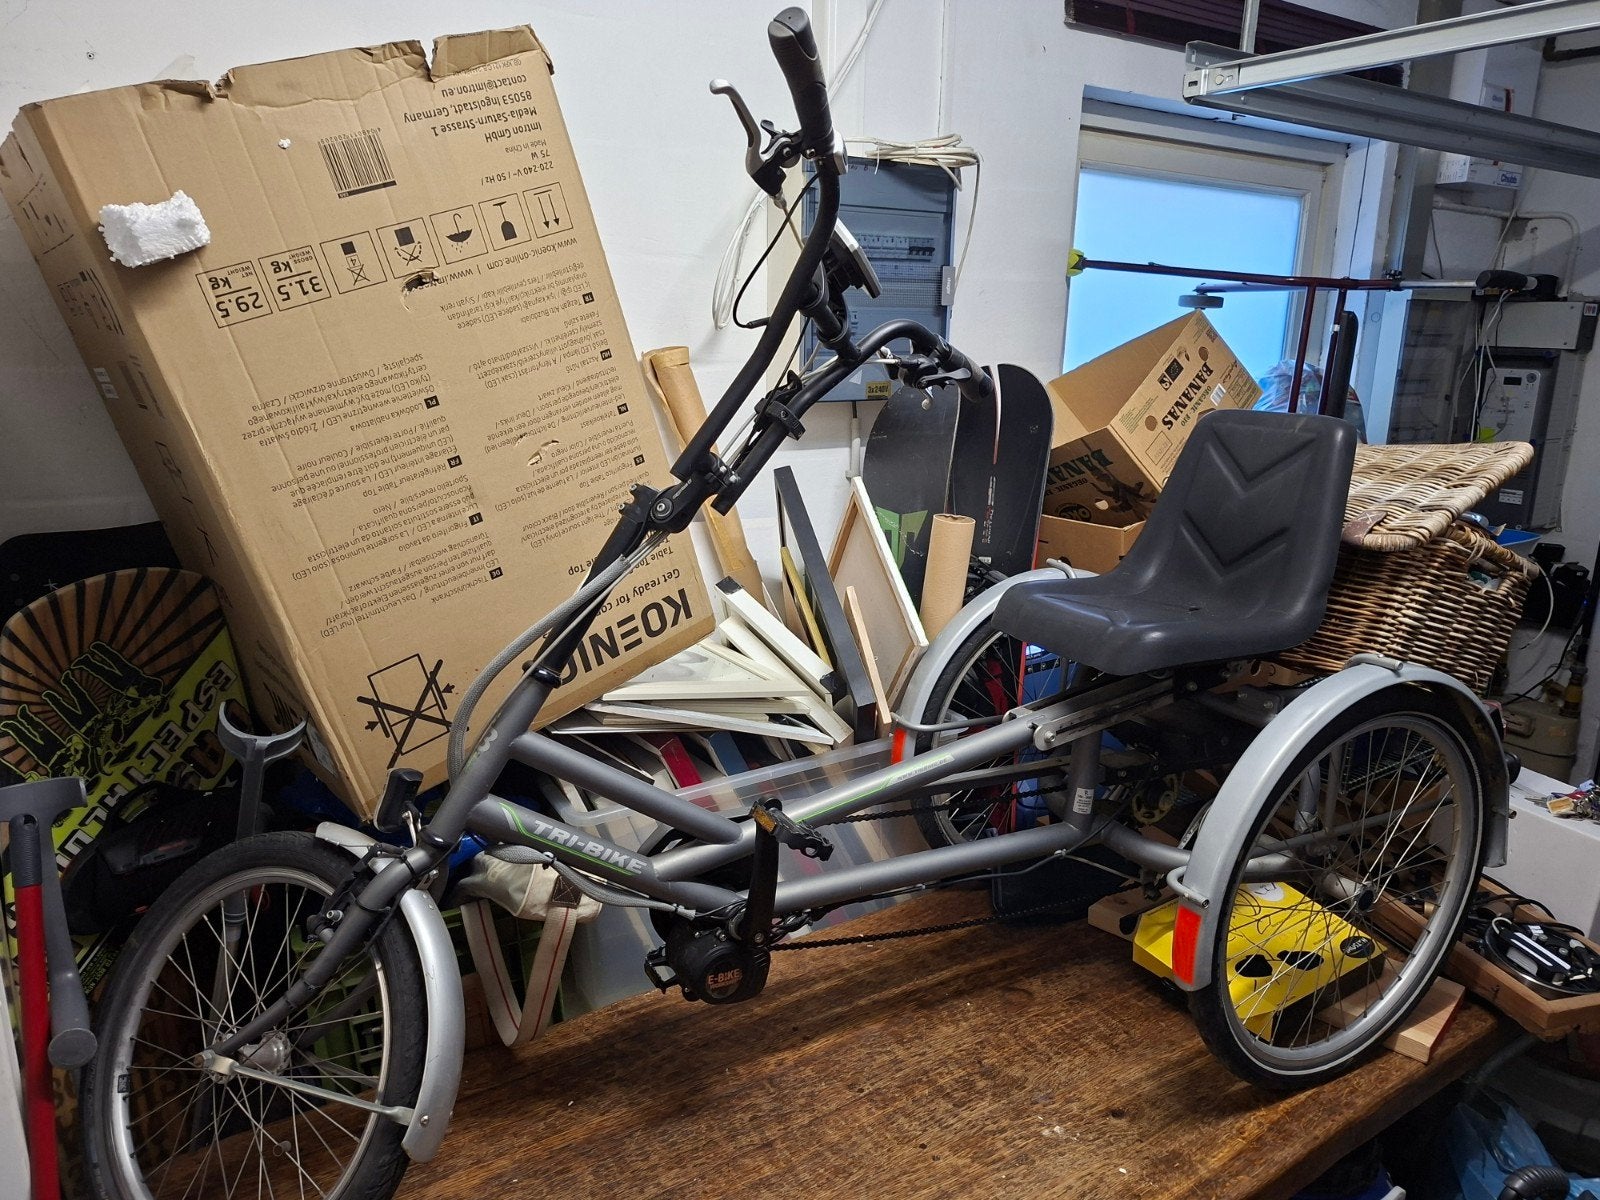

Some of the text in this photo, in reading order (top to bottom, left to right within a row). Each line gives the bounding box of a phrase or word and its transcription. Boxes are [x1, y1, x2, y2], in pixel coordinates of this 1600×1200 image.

[441, 74, 526, 97] contact@imtron.eu
[403, 90, 532, 122] 85053 Ingolstadt, Germany
[430, 106, 536, 137] Media-Saturn-Strasse 1
[484, 121, 542, 142] Imtron GmbH
[504, 144, 522, 153] China
[530, 138, 546, 147] Made
[530, 148, 550, 160] 75 W
[522, 160, 553, 174] 220-240
[484, 174, 495, 183] Hz
[496, 172, 506, 181] 50
[1501, 173, 1518, 184] Chubb
[288, 250, 310, 259] WEIGHT
[293, 255, 313, 264] GROSS
[486, 237, 577, 269] www.koenic-online.com
[227, 265, 250, 275] WEIGHT
[270, 260, 292, 273] kg
[208, 276, 231, 290] kg
[277, 275, 322, 301] 31.5
[215, 291, 263, 318] 29.5
[409, 372, 430, 385] (tylko
[251, 368, 375, 411] Dwustronne drzwiczki Czarna
[370, 387, 391, 398] może
[391, 381, 410, 392] LED)
[355, 393, 370, 404] być
[1161, 362, 1214, 431] BANANAS
[342, 399, 390, 418] wewnętrzne
[325, 414, 342, 426] LED
[241, 426, 265, 440] przez
[438, 424, 449, 434] par
[437, 434, 453, 446] (LED
[296, 427, 413, 471] Porte réversible Couleur noire
[390, 441, 436, 462] uniquement)
[346, 467, 363, 477] être
[363, 461, 379, 471] doit
[1046, 448, 1114, 487] BANA
[309, 468, 325, 478] une
[377, 467, 393, 479] LED
[399, 463, 446, 484] Réfrigérateur
[270, 473, 309, 492] personne
[306, 473, 346, 491] remplacée
[334, 479, 360, 492] source
[377, 481, 398, 491] Table
[289, 486, 305, 497] que
[362, 488, 377, 497] Top
[372, 503, 391, 514] Nero
[371, 521, 402, 537] soltanto
[416, 521, 431, 532] LED
[365, 533, 398, 550] sorgente
[398, 538, 421, 551] tavolo
[409, 548, 448, 567] wechselbar
[469, 555, 481, 563] nur
[481, 549, 495, 560] darf
[650, 546, 673, 560] Table
[311, 559, 330, 571] (solo
[423, 559, 448, 572] Person
[455, 560, 469, 569] von
[485, 557, 498, 568] LED
[567, 563, 585, 575] Top
[291, 568, 311, 580] LED)
[380, 566, 401, 578] Farbe
[431, 576, 487, 603] Tischkühlschrank
[615, 568, 680, 606] Get ready for
[345, 589, 373, 604] werden
[401, 592, 416, 602] Das
[354, 599, 401, 623] Leuchtmittel
[339, 617, 354, 629] (nur
[320, 625, 339, 638] LED)
[533, 819, 648, 876] TRI-BIKE
[707, 968, 742, 985] E-BIKE
